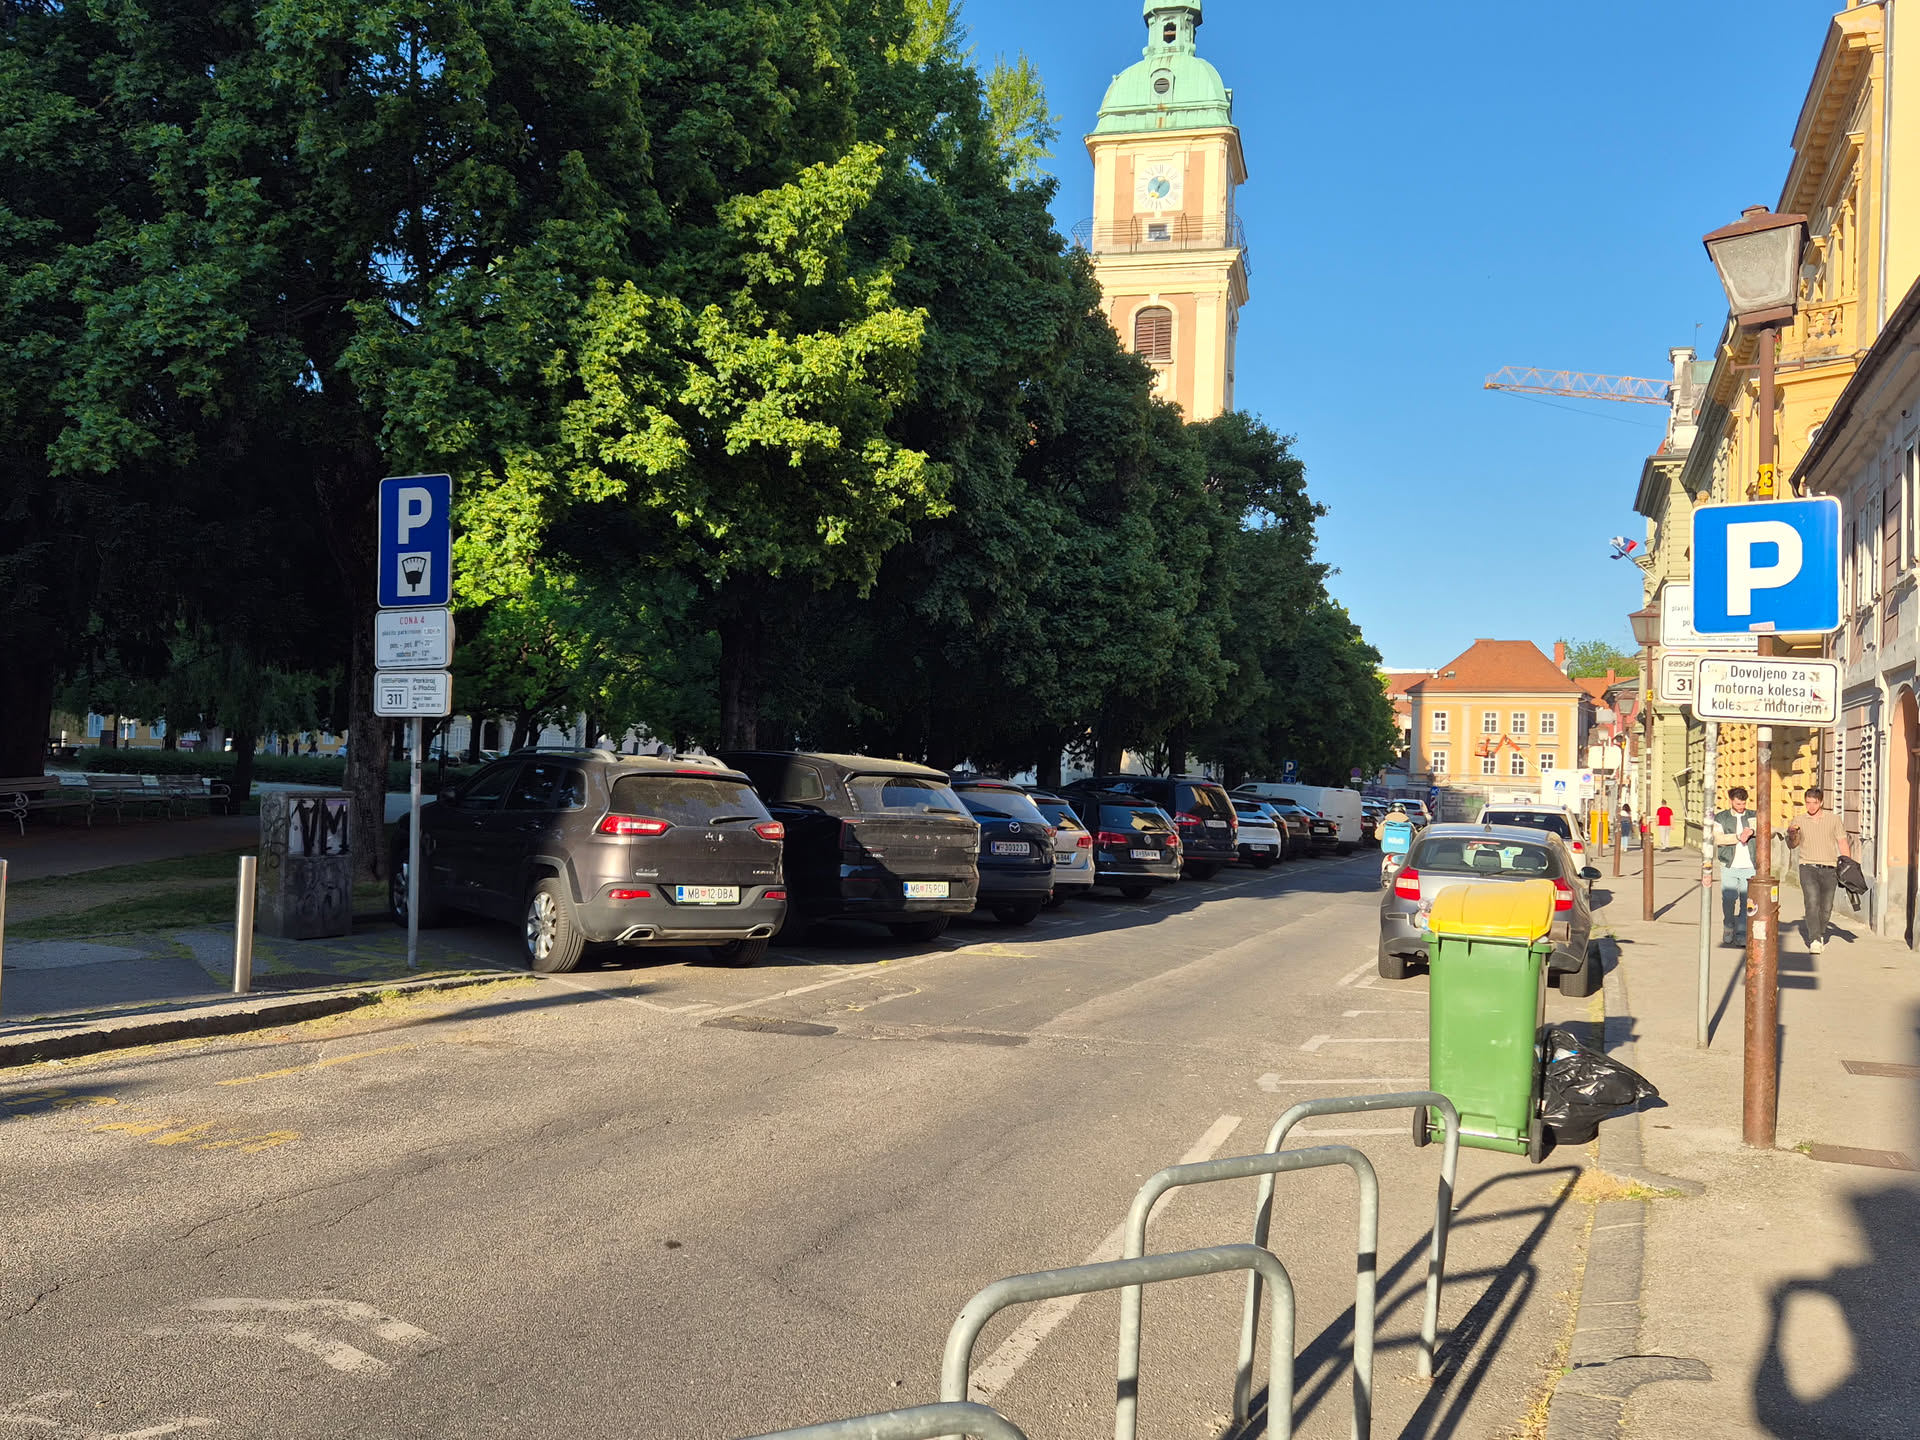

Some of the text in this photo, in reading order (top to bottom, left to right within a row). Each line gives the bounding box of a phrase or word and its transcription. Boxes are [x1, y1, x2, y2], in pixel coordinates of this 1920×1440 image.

[398, 487, 432, 544] P
[1727, 521, 1803, 616] P
[400, 616, 425, 625] CONA 4
[1682, 619, 1691, 627] po
[1730, 665, 1787, 682] Dovoljeno
[1792, 671, 1805, 680] za
[1676, 678, 1692, 691] 31
[1714, 682, 1763, 696] motorna
[1768, 683, 1806, 697] kolesa
[387, 694, 402, 705] 311
[1286, 762, 1294, 773] P
[688, 888, 734, 899] MB 12-DBA
